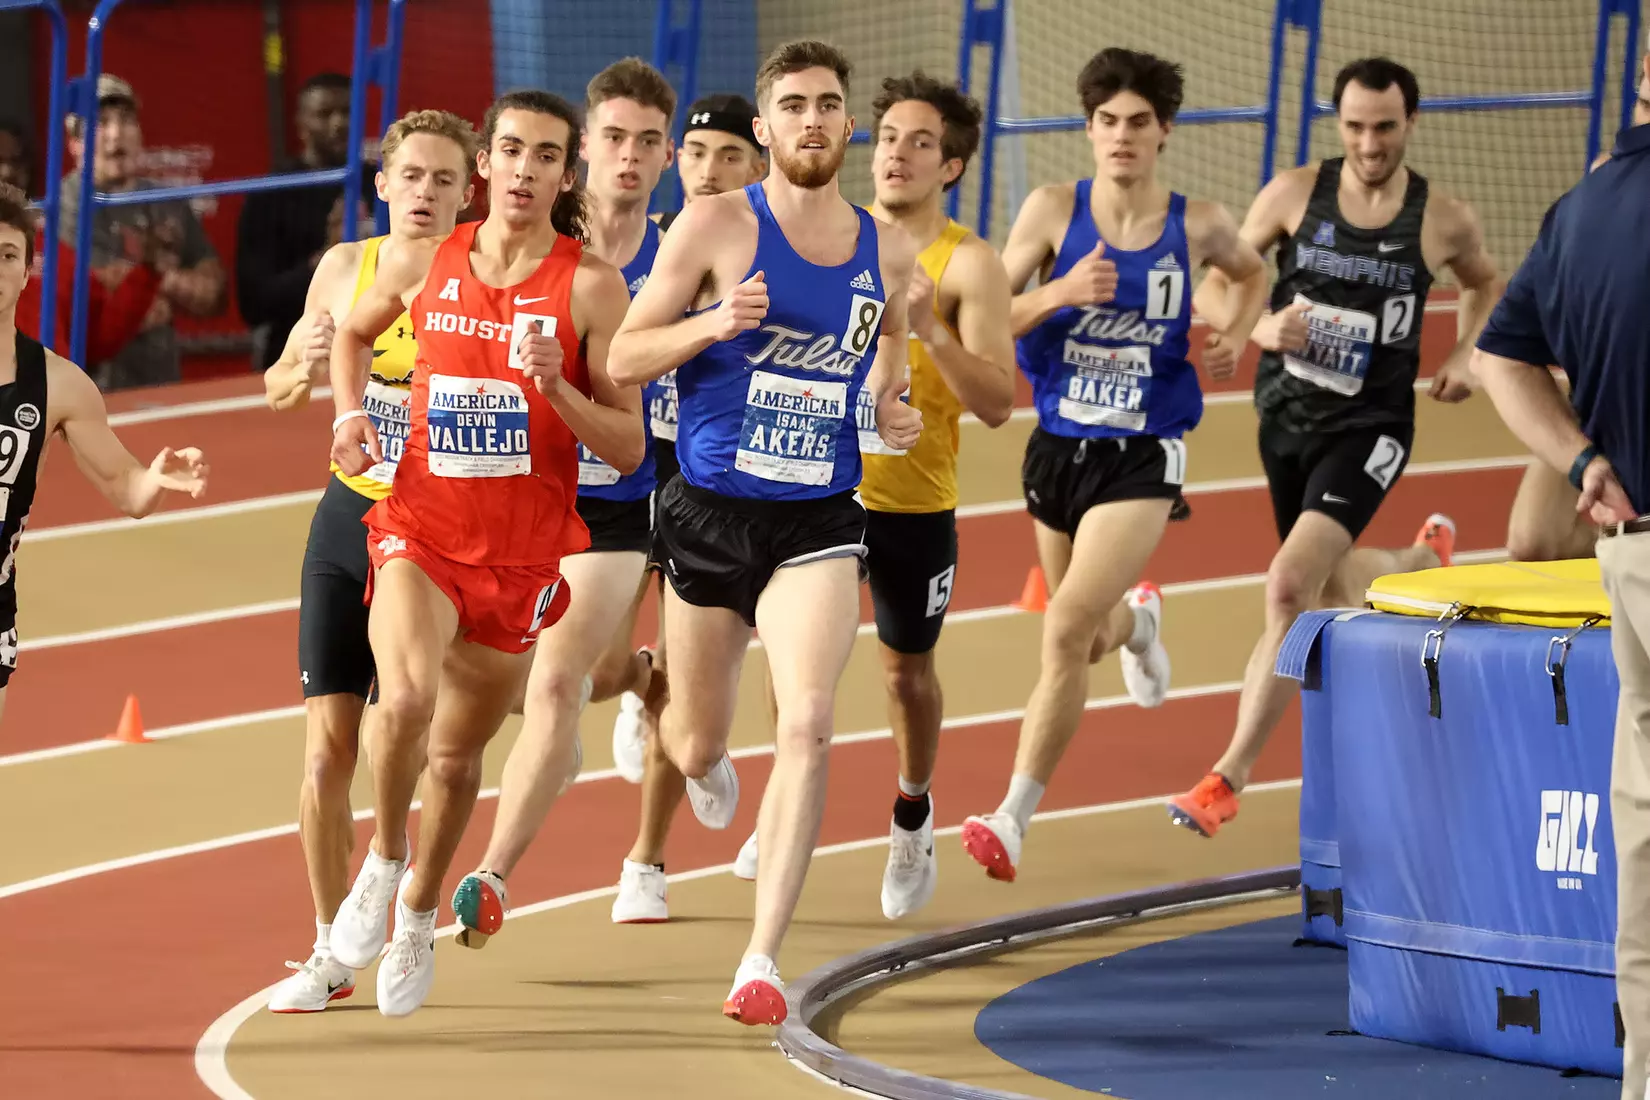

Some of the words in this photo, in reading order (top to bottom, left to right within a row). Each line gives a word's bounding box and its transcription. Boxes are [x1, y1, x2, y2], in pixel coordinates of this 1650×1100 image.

[1296, 242, 1416, 291] MEMPHIS
[438, 278, 461, 301] A
[850, 280, 876, 293] adidas
[1158, 274, 1172, 317] 1
[423, 311, 514, 343] HOUST
[851, 302, 878, 352] 8
[1067, 305, 1168, 346] Tulsa
[1388, 300, 1408, 340] 2
[743, 323, 862, 377] Tulsa
[1068, 350, 1147, 373] AMERICAN
[432, 391, 520, 410] AMERICAN
[649, 398, 678, 422] HA
[751, 388, 840, 416] AMERICAN
[1067, 375, 1144, 411] BAKER
[456, 413, 496, 428] DEVIN
[776, 411, 815, 432] ISAAC
[0, 429, 19, 478] 9
[427, 424, 528, 453] VALLEJO
[748, 424, 830, 459] AKERS
[1373, 441, 1398, 482] 2
[934, 571, 950, 612] 5
[1536, 789, 1600, 875] GILL
